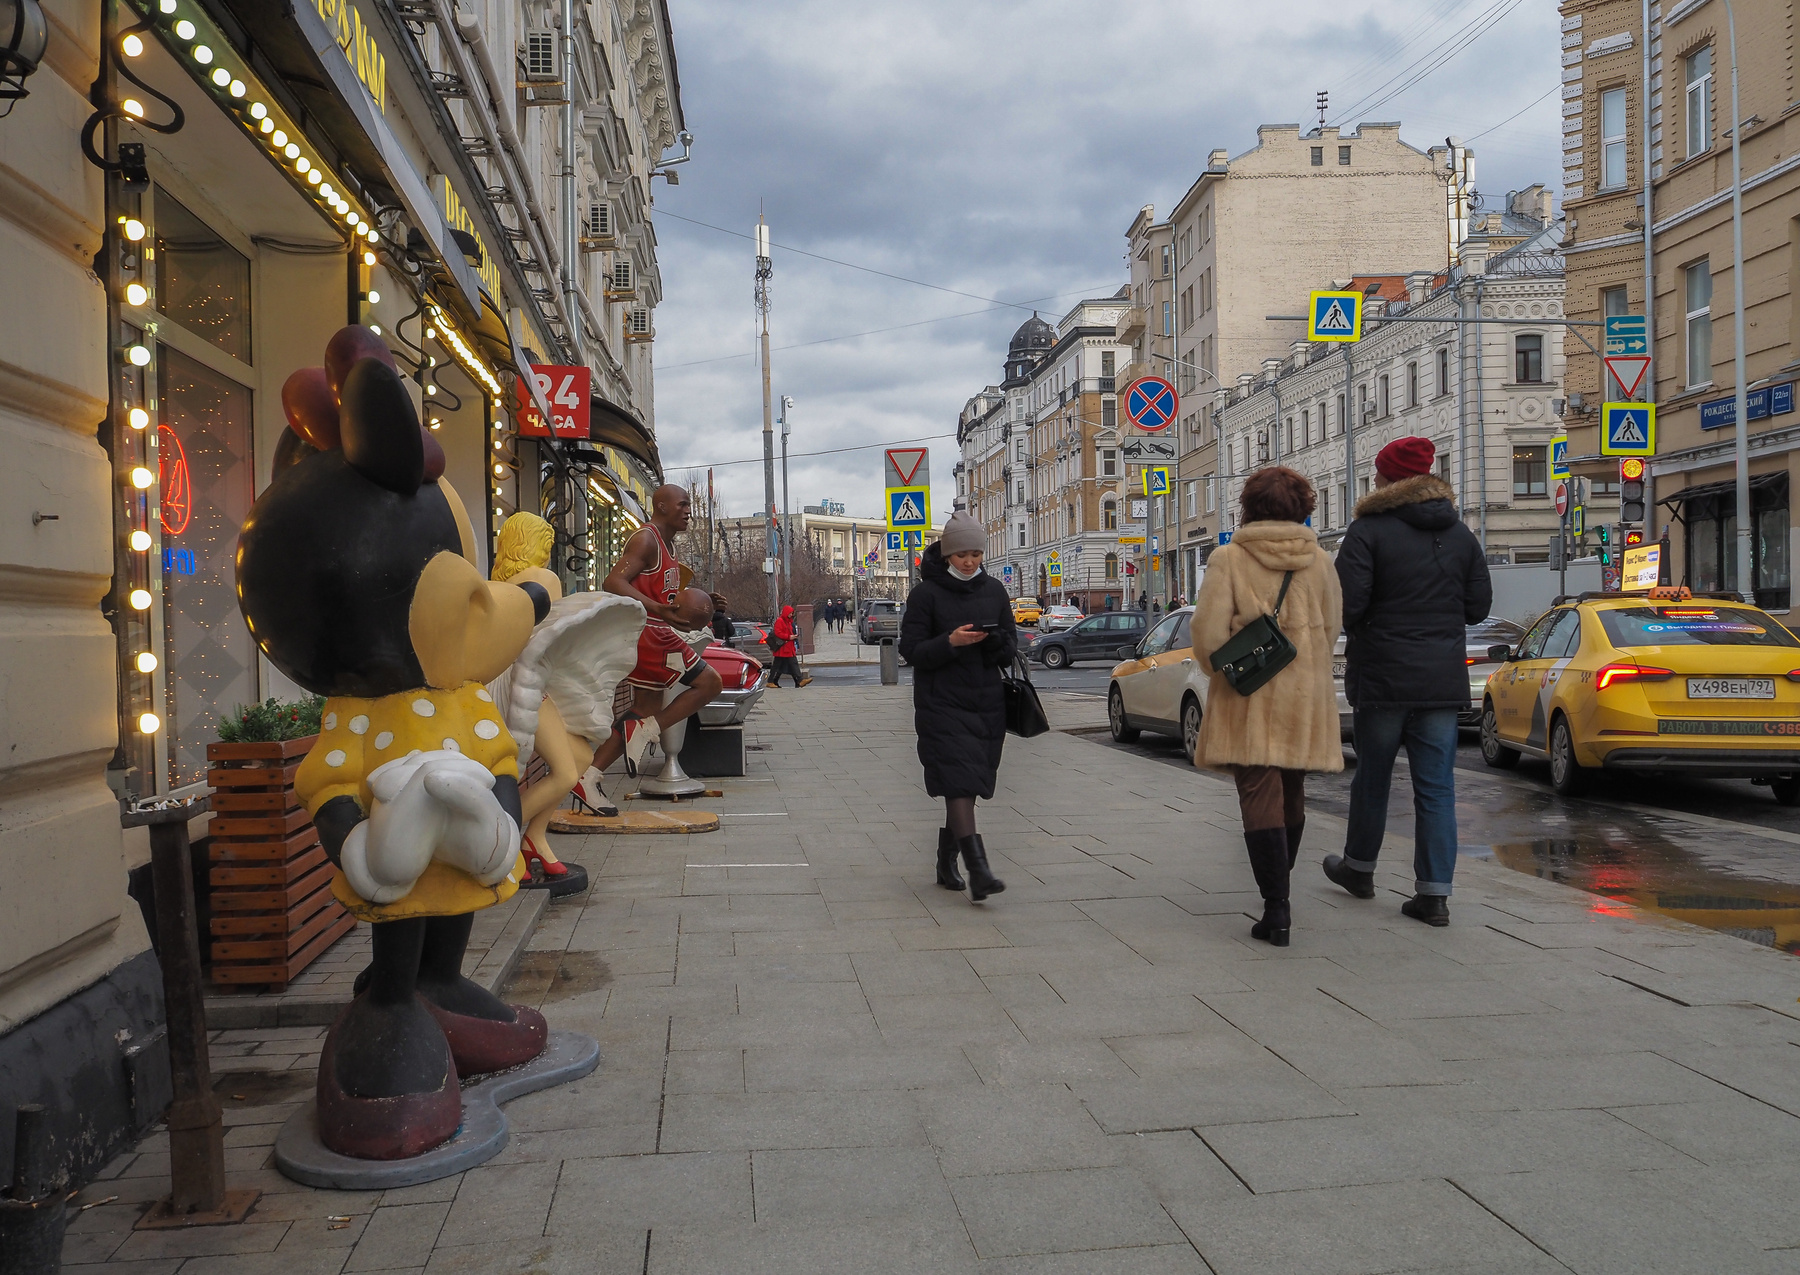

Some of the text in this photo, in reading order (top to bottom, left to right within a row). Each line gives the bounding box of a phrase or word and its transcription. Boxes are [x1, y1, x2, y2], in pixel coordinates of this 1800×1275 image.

[1704, 394, 1763, 417] РОЖДЕСТВСКИЙ
[829, 502, 845, 514] ВТБ
[1749, 680, 1770, 690] 797
[1659, 721, 1706, 734] РАБОТА
[1712, 722, 1719, 734] В
[1723, 722, 1764, 734] ТАКСИ
